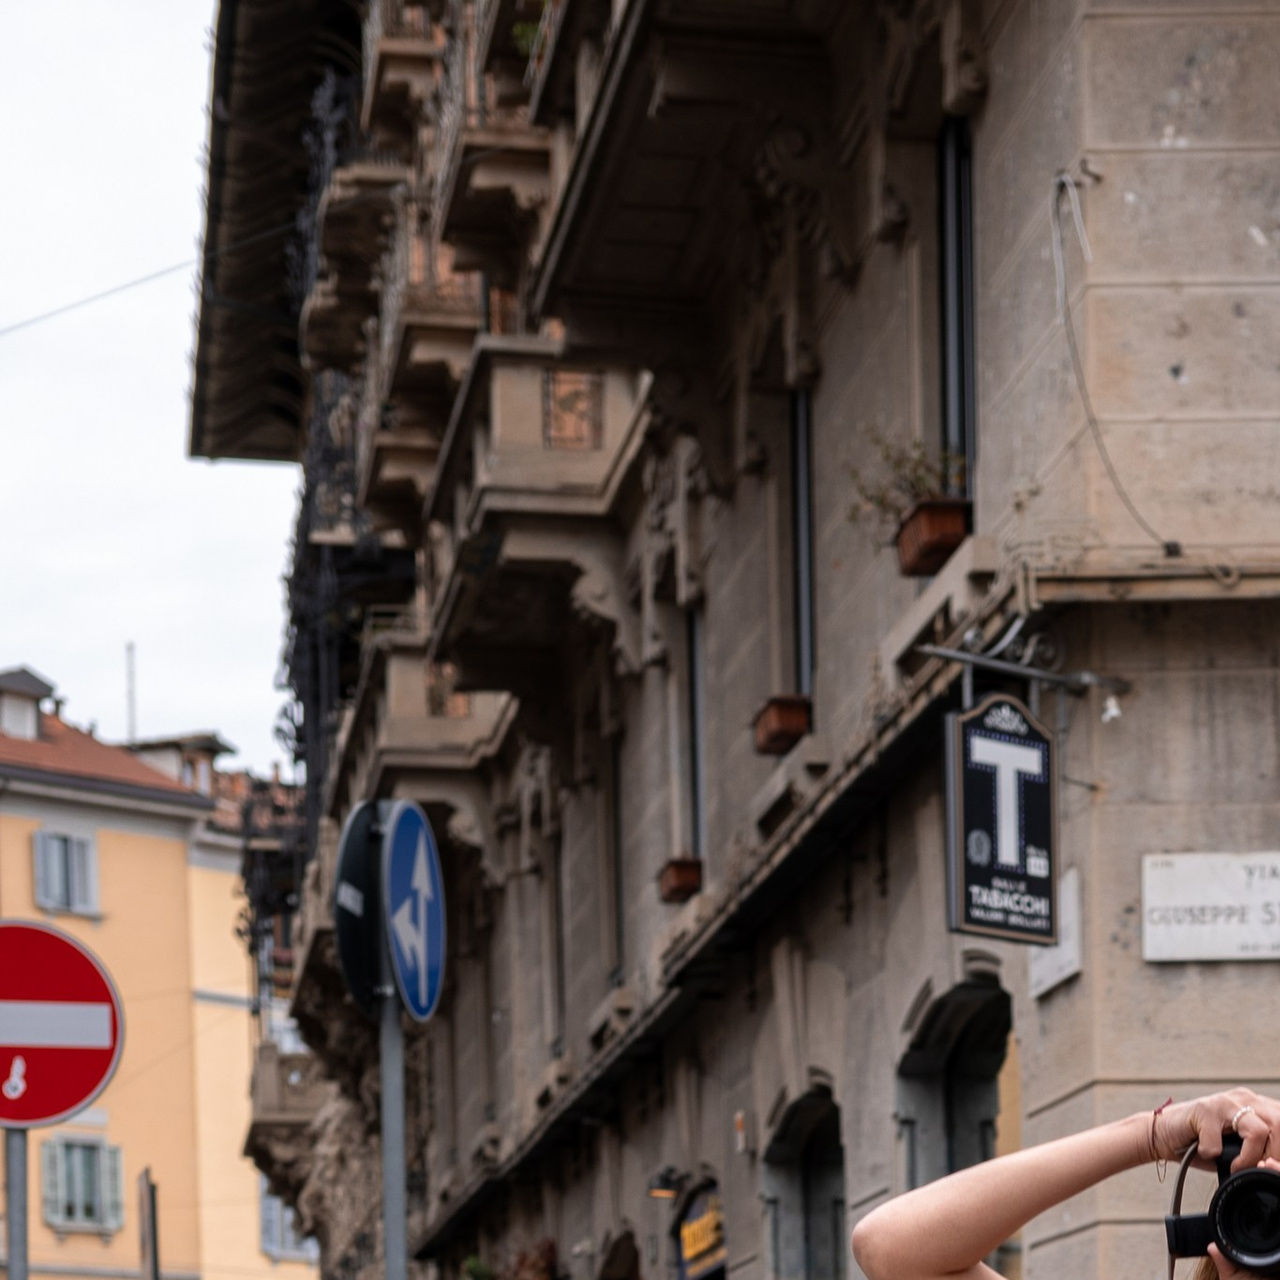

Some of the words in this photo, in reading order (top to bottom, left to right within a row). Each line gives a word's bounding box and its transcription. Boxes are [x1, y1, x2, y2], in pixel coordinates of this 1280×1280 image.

[970, 734, 1043, 866] T
[968, 884, 1050, 916] TABACCHI
[1148, 905, 1250, 926] GIUSEPPE
